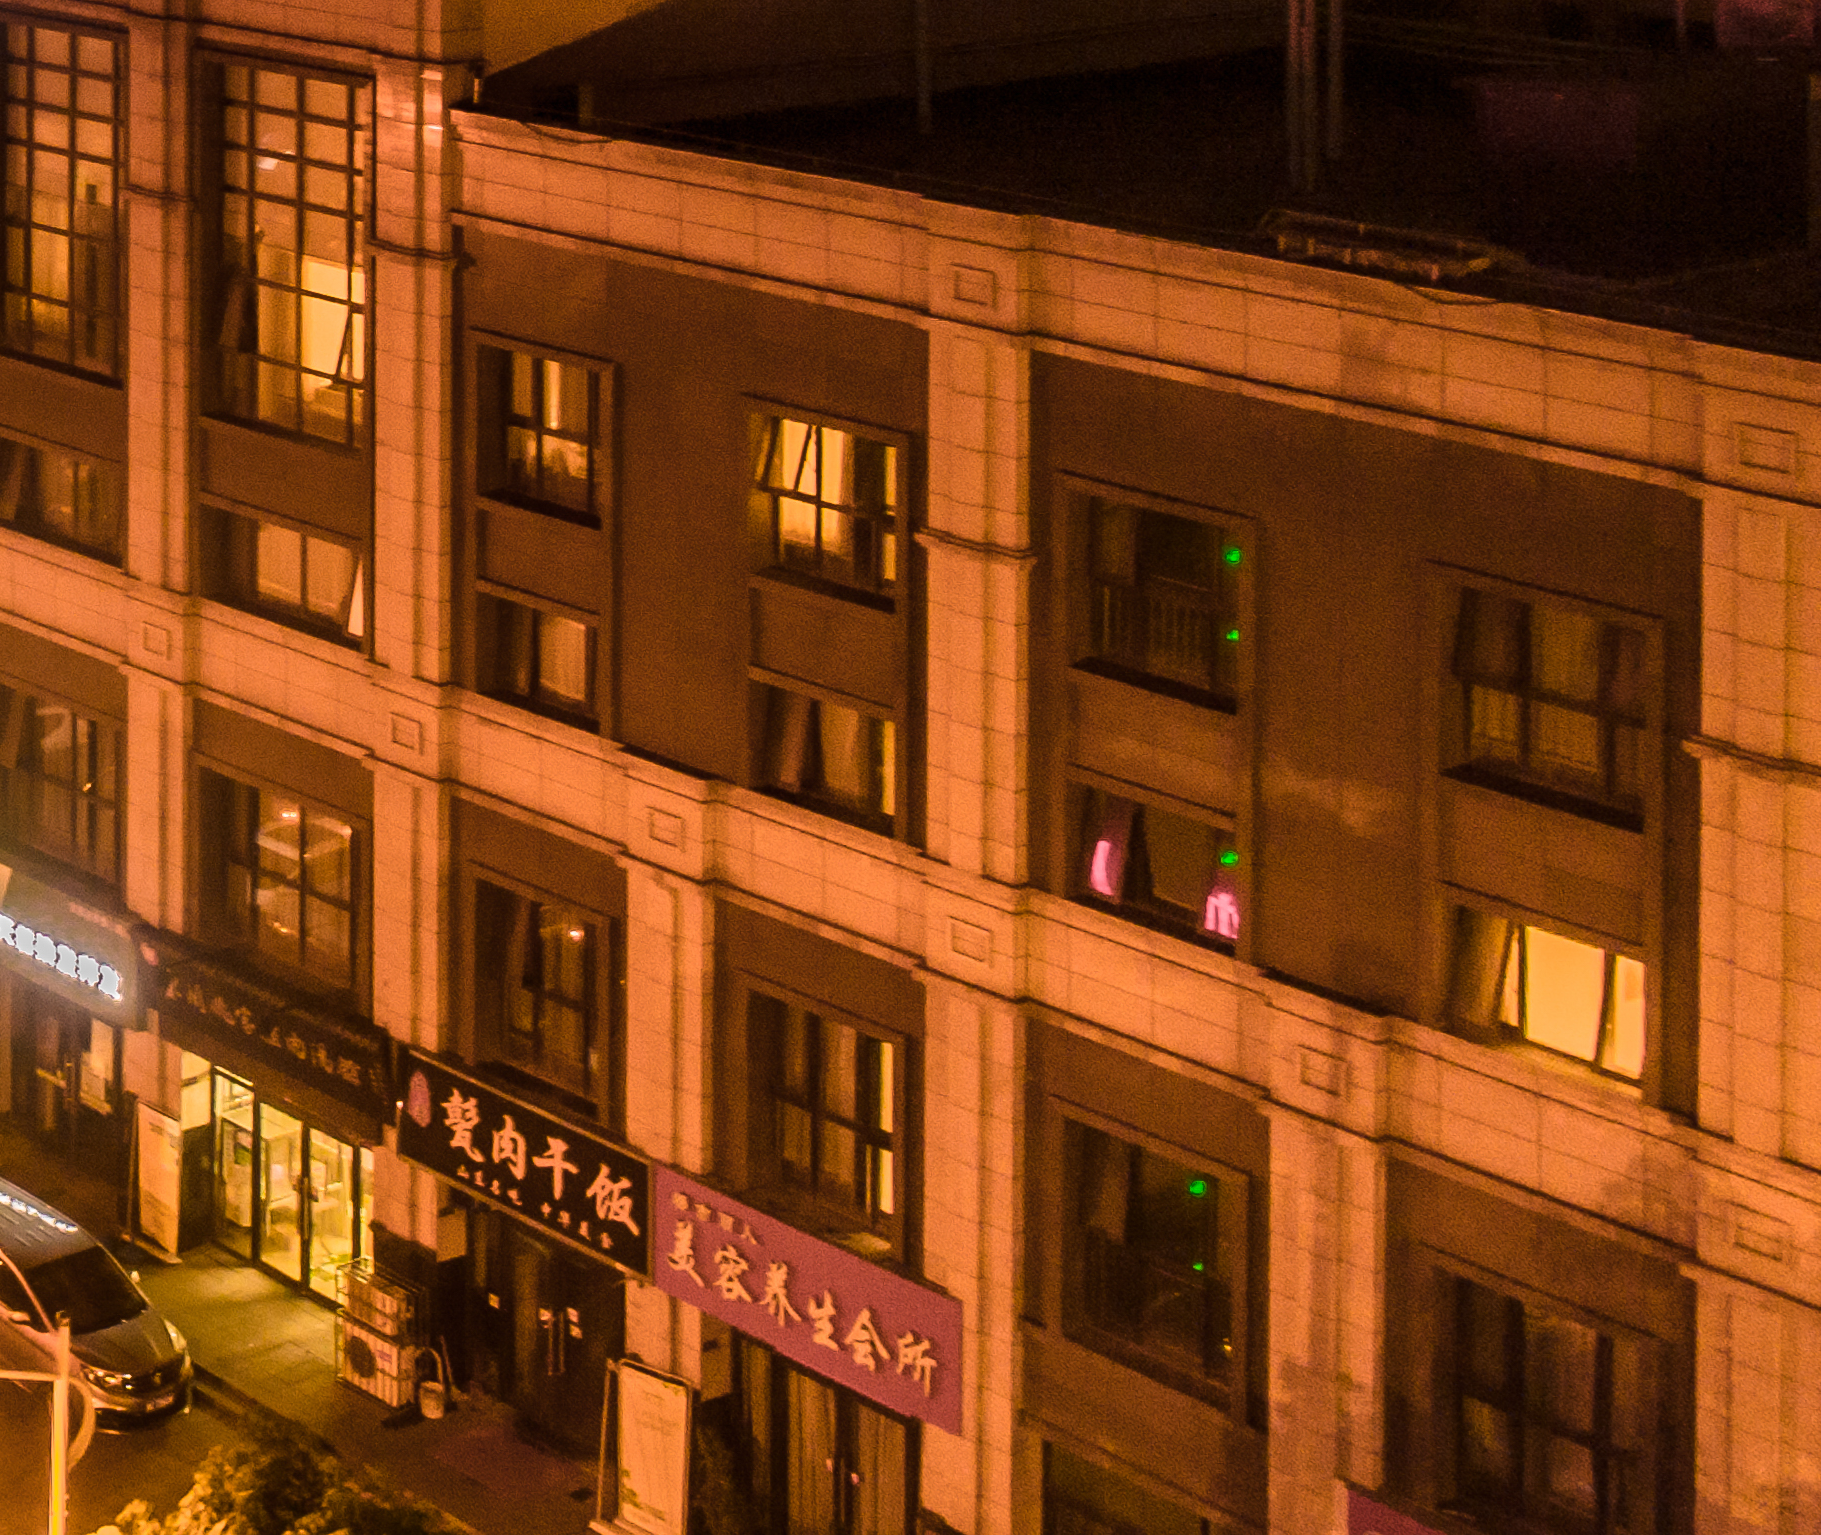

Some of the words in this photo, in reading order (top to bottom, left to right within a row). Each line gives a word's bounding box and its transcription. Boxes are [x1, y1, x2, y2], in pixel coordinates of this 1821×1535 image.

[667, 1219, 938, 1397] 美容养生会所
